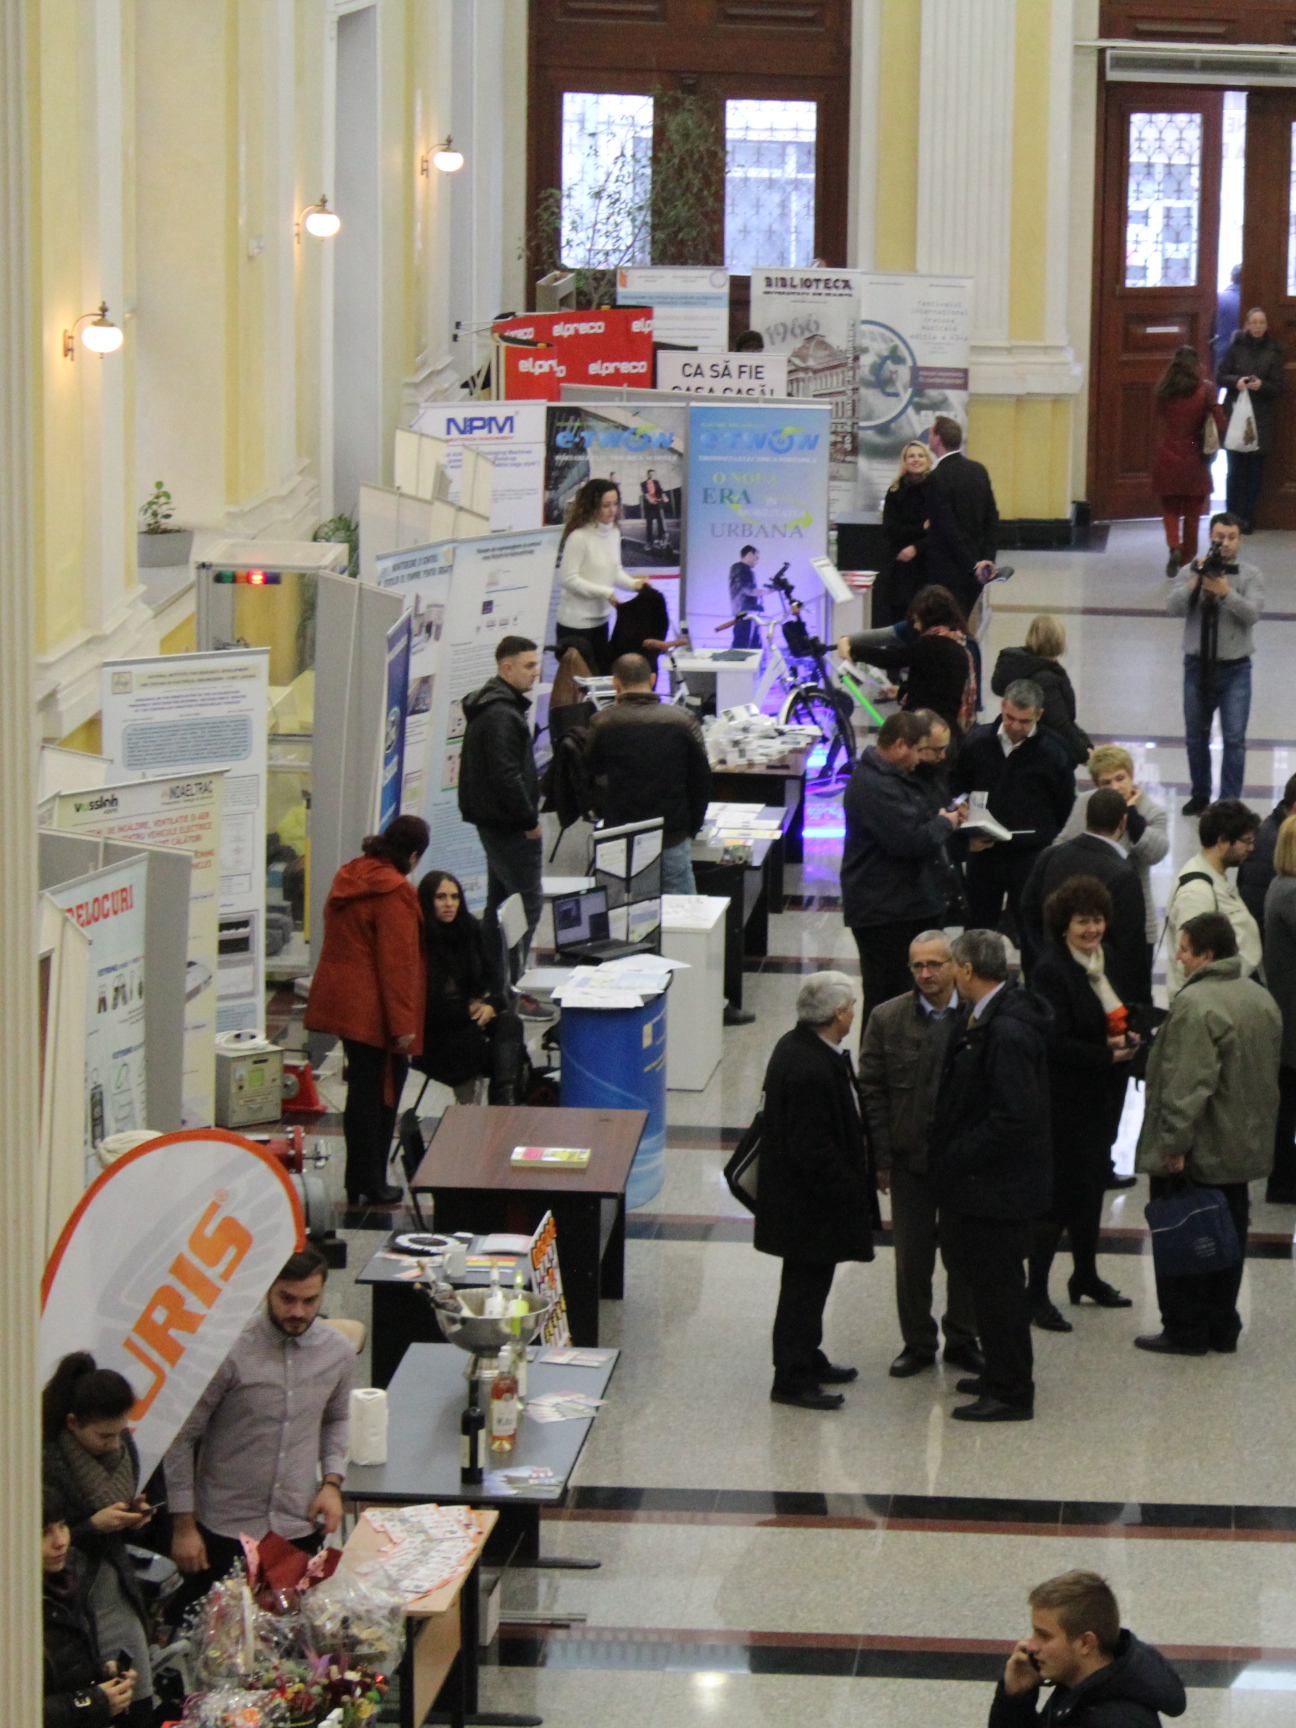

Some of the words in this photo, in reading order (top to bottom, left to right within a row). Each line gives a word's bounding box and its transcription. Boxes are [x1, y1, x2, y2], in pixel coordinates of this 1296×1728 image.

[765, 277, 852, 290] BIBLIOTECA
[552, 321, 606, 339] elpreco
[766, 313, 820, 345] 1966
[588, 359, 648, 376] elpreco
[682, 362, 705, 379] CA
[709, 360, 732, 380] SĂ
[738, 364, 765, 380] FIE
[446, 415, 514, 436] NPM
[702, 487, 751, 505] ERA
[710, 523, 804, 539] URBANA
[122, 1200, 254, 1434] URIS
